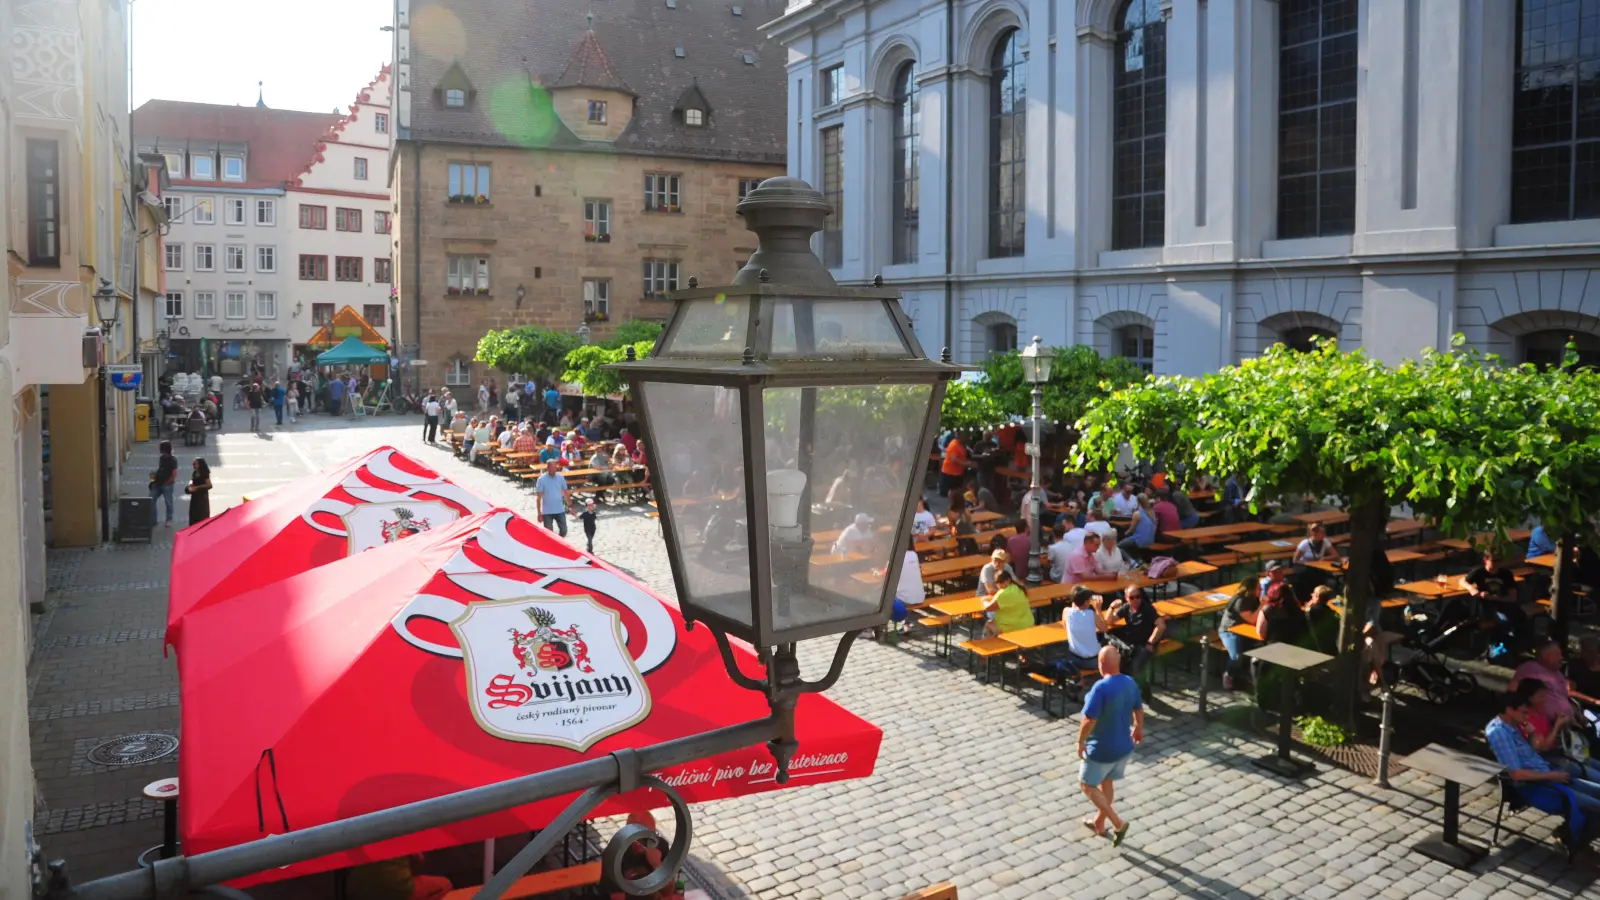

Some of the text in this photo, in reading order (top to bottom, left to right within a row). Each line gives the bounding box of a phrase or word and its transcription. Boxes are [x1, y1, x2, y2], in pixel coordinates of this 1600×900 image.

[485, 673, 633, 710] Svijany
[516, 703, 618, 721] český rodinný pivovar
[561, 719, 584, 727] 1564
[712, 765, 746, 787] pivo
[749, 759, 772, 776] bez
[775, 751, 849, 778] asterizace
